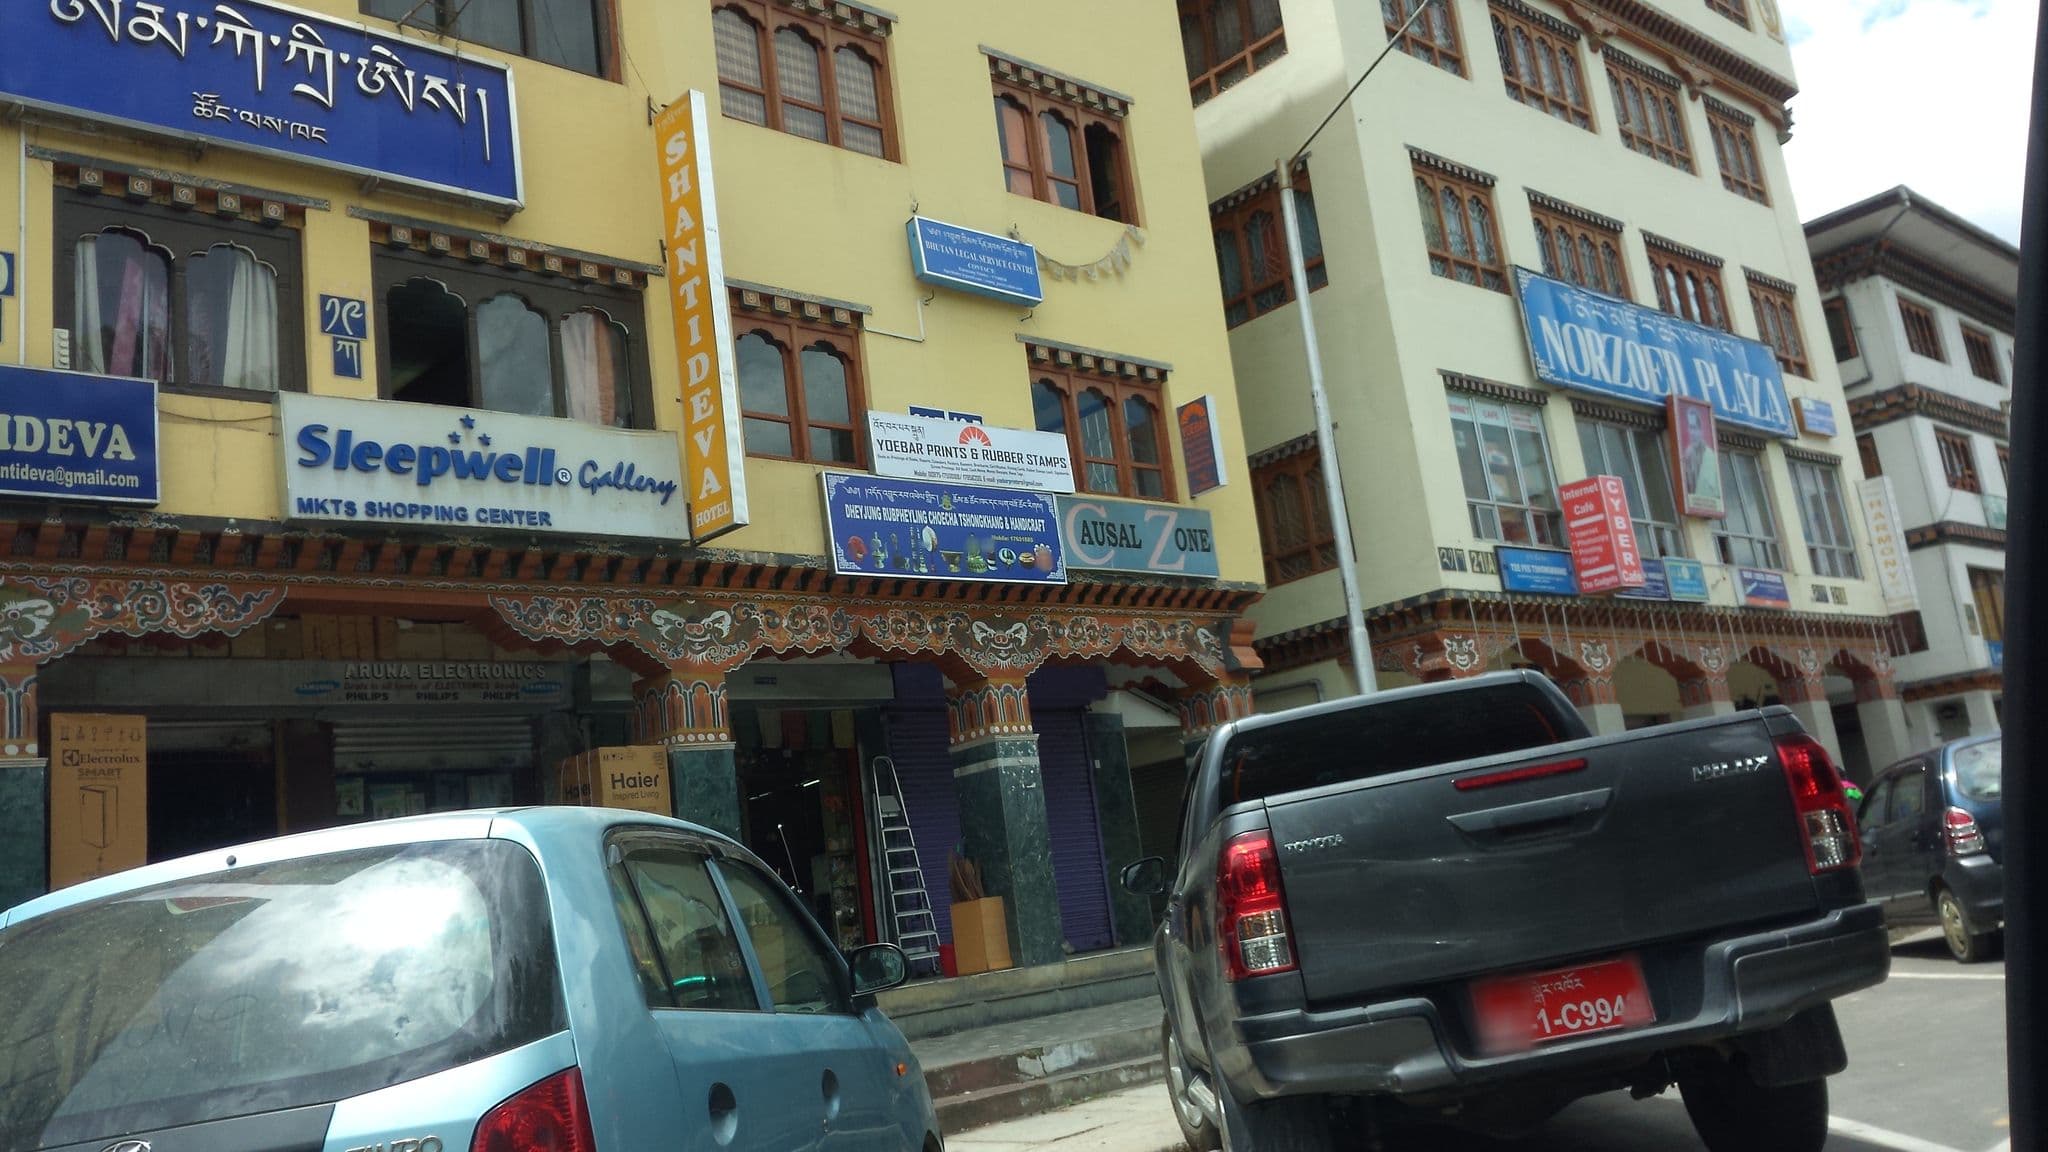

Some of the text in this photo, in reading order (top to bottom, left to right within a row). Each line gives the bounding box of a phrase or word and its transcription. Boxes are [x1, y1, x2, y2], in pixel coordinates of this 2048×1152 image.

[925, 240, 955, 257] BHUTAN
[955, 246, 977, 261] LEGAL
[979, 255, 1008, 270] SERVICE
[1008, 261, 1035, 275] CENTRE
[665, 130, 722, 500] SHANTIDEVA
[1692, 356, 1786, 425] PLAZA
[876, 438, 924, 455] YOEBAR
[926, 443, 968, 460] PRINTS
[971, 448, 979, 460] &
[982, 449, 1024, 465] RUBBER
[1026, 453, 1067, 469] STAMPS
[577, 459, 678, 506] Gallery
[1562, 482, 1599, 500] Internet
[297, 497, 552, 527] MKTS SHOPPING CENTER
[695, 501, 730, 528] HOTEL
[1010, 517, 1046, 533] HANDICRAFT
[1606, 480, 1636, 567] CYBER
[1065, 502, 1211, 571] CAUSAL ZONE
[344, 663, 546, 680] ARUNA ELECTRONICS
[77, 768, 123, 777] SMART
[80, 752, 141, 765] Electrolux
[611, 771, 659, 789] Haier
